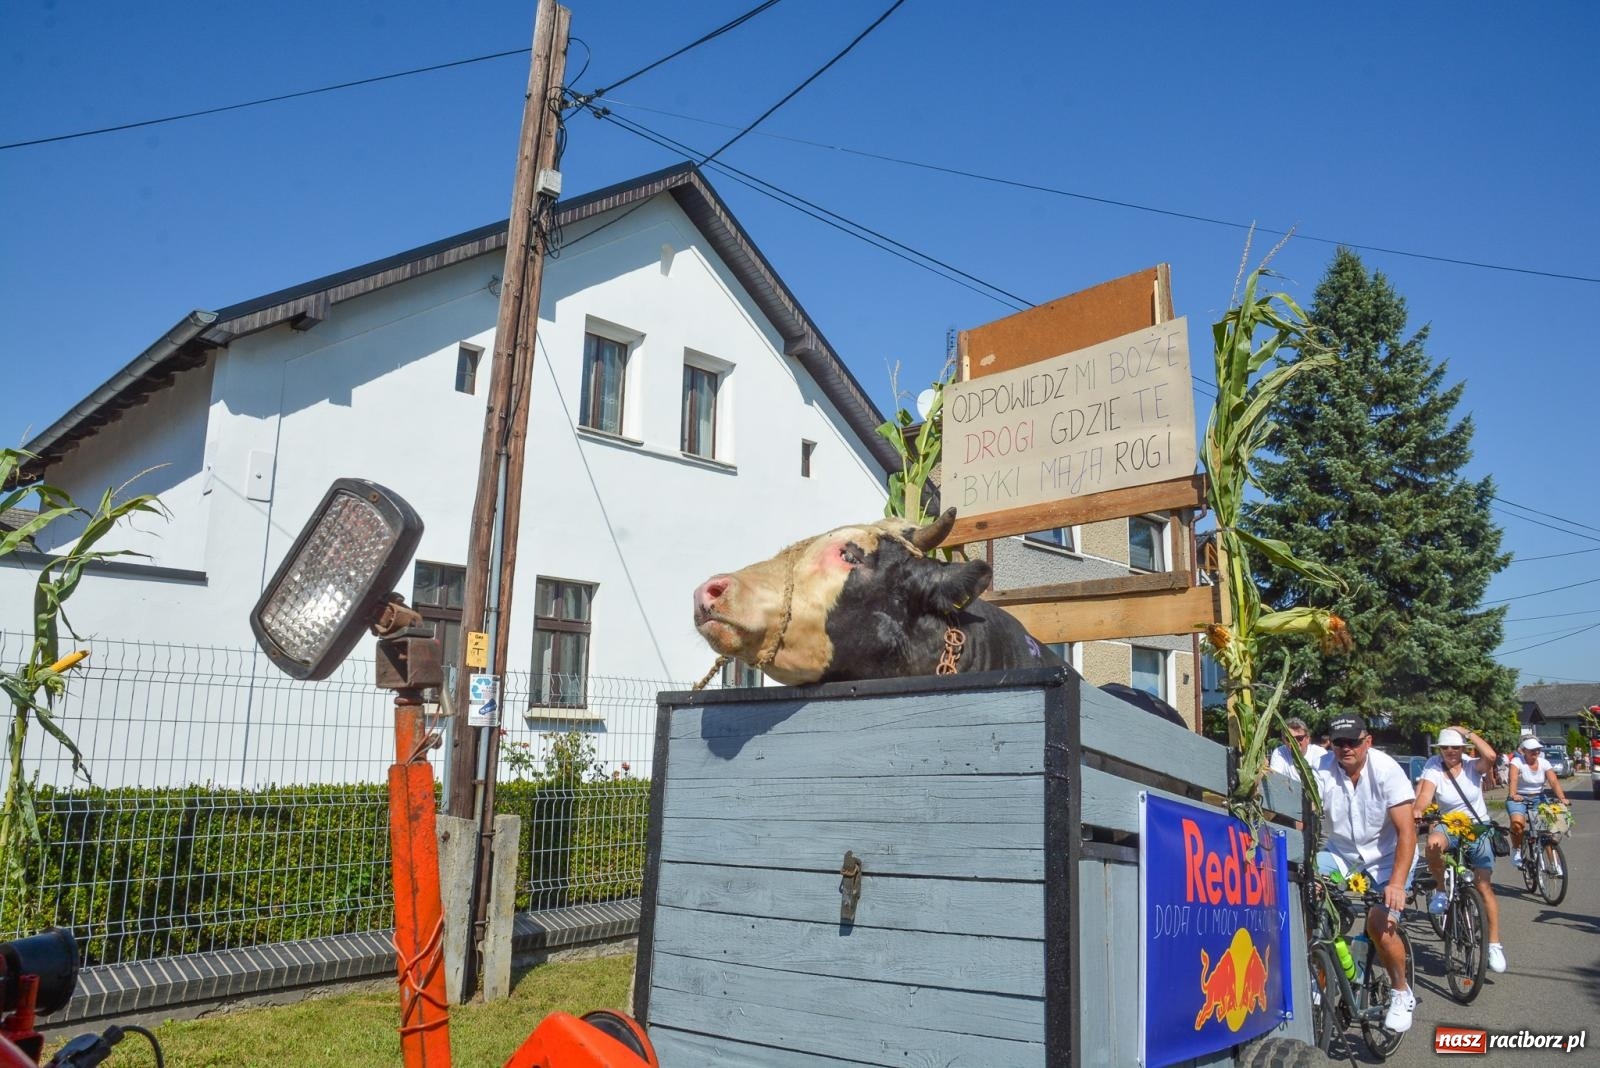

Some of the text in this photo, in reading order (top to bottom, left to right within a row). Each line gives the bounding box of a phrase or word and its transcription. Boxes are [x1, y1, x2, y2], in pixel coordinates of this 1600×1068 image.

[951, 367, 1069, 424] ODPOWIEDZ
[1075, 359, 1096, 397] MI
[963, 382, 1169, 465] DROGI GDZIE TE
[963, 467, 1020, 507] BYKI
[1115, 431, 1172, 475] ROGI
[1182, 817, 1242, 906] Red
[1153, 904, 1190, 939] DODA
[1196, 906, 1208, 936] CI
[1212, 908, 1238, 936] MOCY
